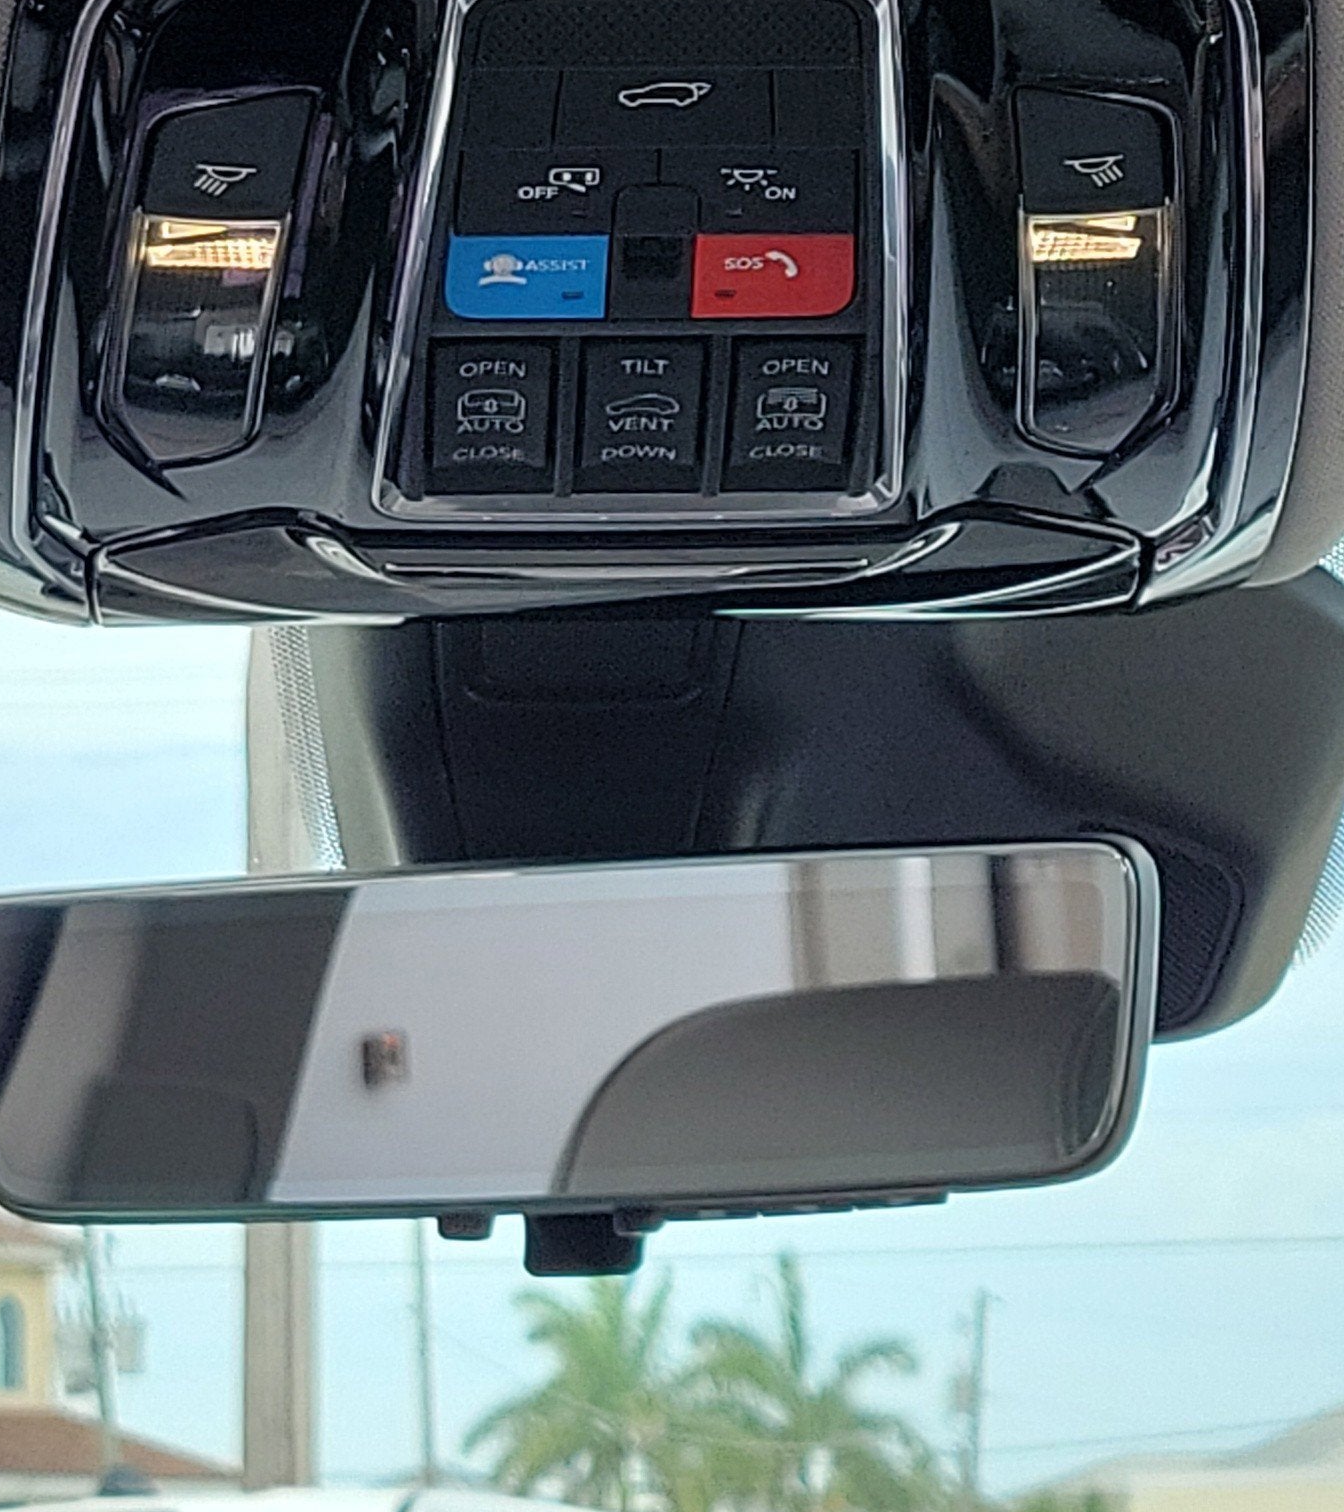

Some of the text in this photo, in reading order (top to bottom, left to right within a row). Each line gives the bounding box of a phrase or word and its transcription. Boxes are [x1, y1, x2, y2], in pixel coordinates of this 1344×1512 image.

[518, 186, 559, 200] OFF
[765, 186, 797, 201] ON
[524, 258, 589, 272] ASSIST
[723, 256, 764, 271] SOS
[459, 360, 526, 378] OPEN
[620, 358, 670, 376] TILT
[762, 359, 829, 376] OPEN
[456, 417, 524, 433] AUTO
[608, 417, 674, 433] VENT
[756, 416, 824, 432] AUTO
[452, 446, 524, 462] CLOSE
[601, 445, 677, 462] DOWN
[749, 444, 821, 459] CLOSE
